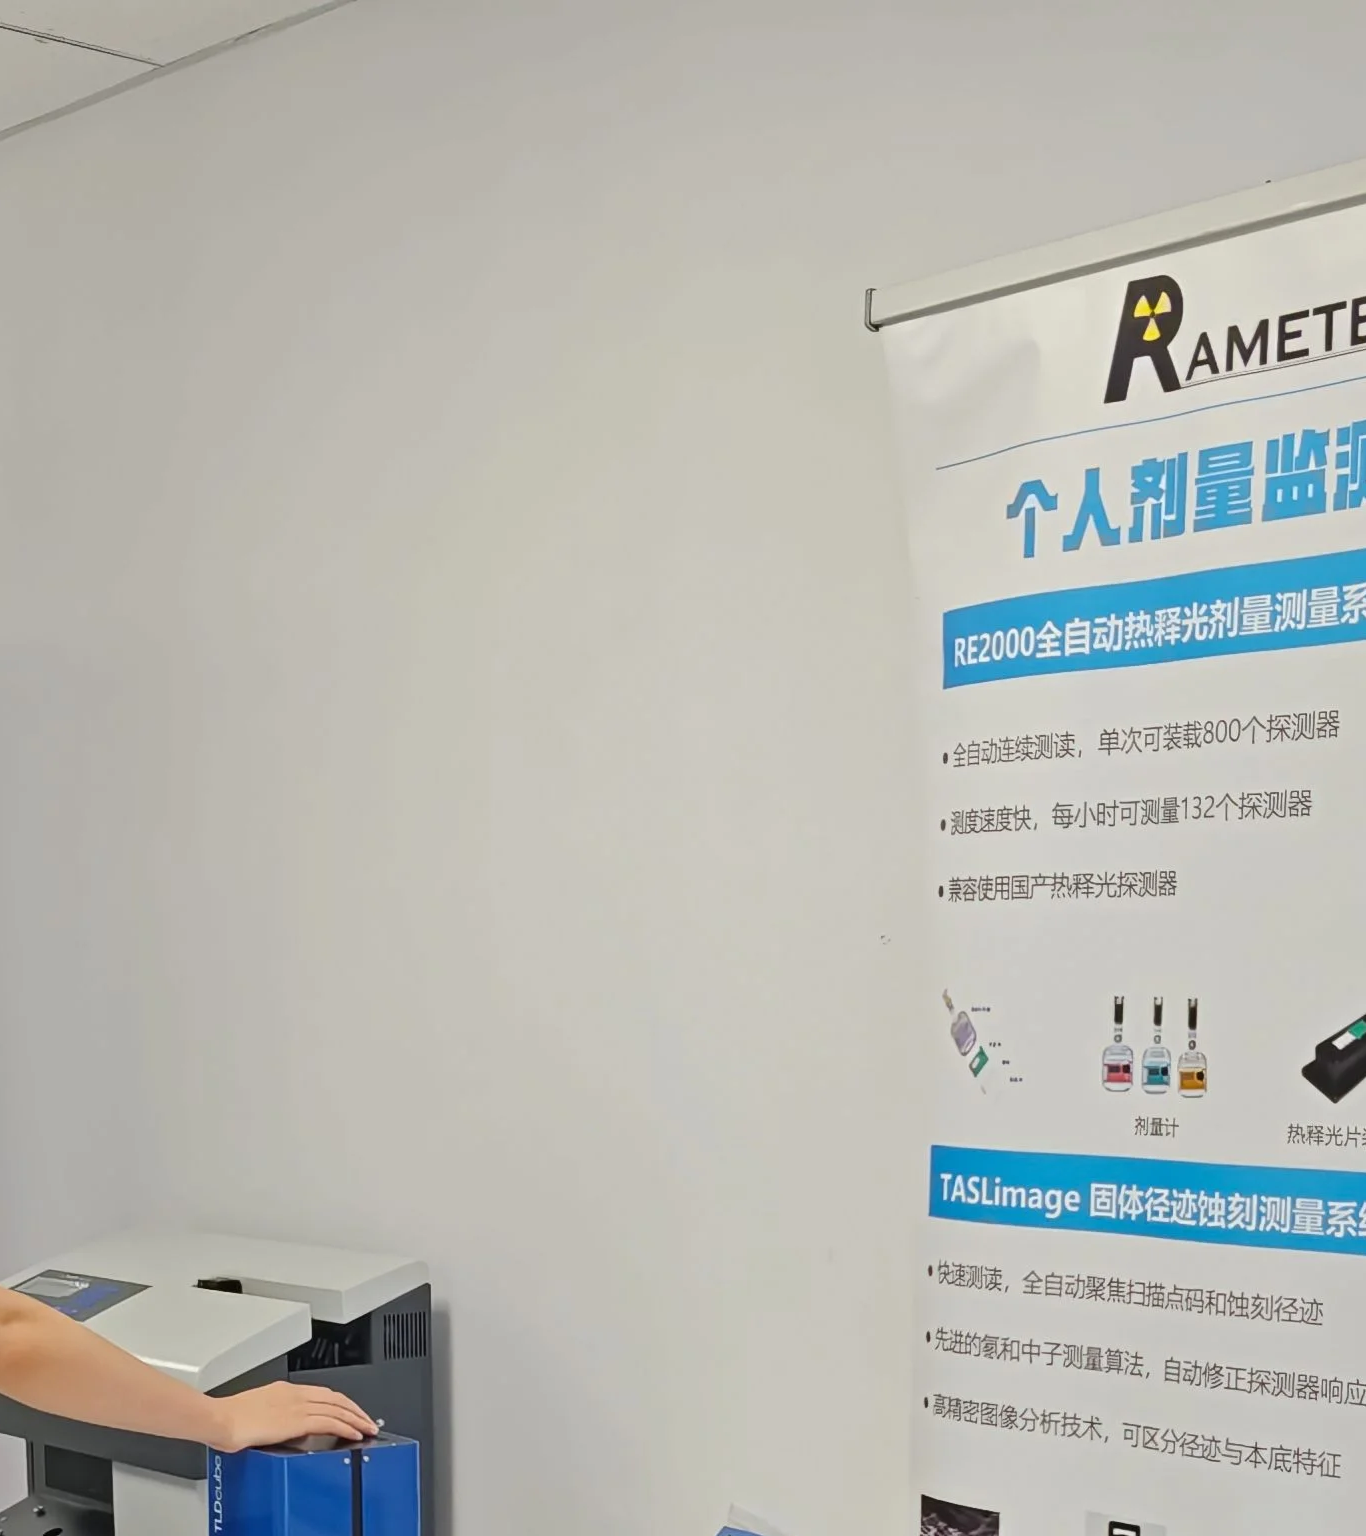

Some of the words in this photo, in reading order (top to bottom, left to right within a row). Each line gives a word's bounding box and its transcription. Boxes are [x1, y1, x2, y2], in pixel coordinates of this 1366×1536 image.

[952, 709, 1341, 770] 全自动连续测读，单次可装载800个探测器
[950, 787, 1313, 835] 测度速度快，每小时可测量132个探测器
[948, 869, 1178, 903] 兼容使用国产热释光探测器
[1134, 1116, 1180, 1138] 剂量计
[939, 1173, 1082, 1221] TASLimage
[937, 1261, 1325, 1327] 快速测读，全自动聚焦扫描点码和蚀刻径迹
[932, 1393, 1343, 1480] 高精密图像分析技术，可区分径迹与本底特征
